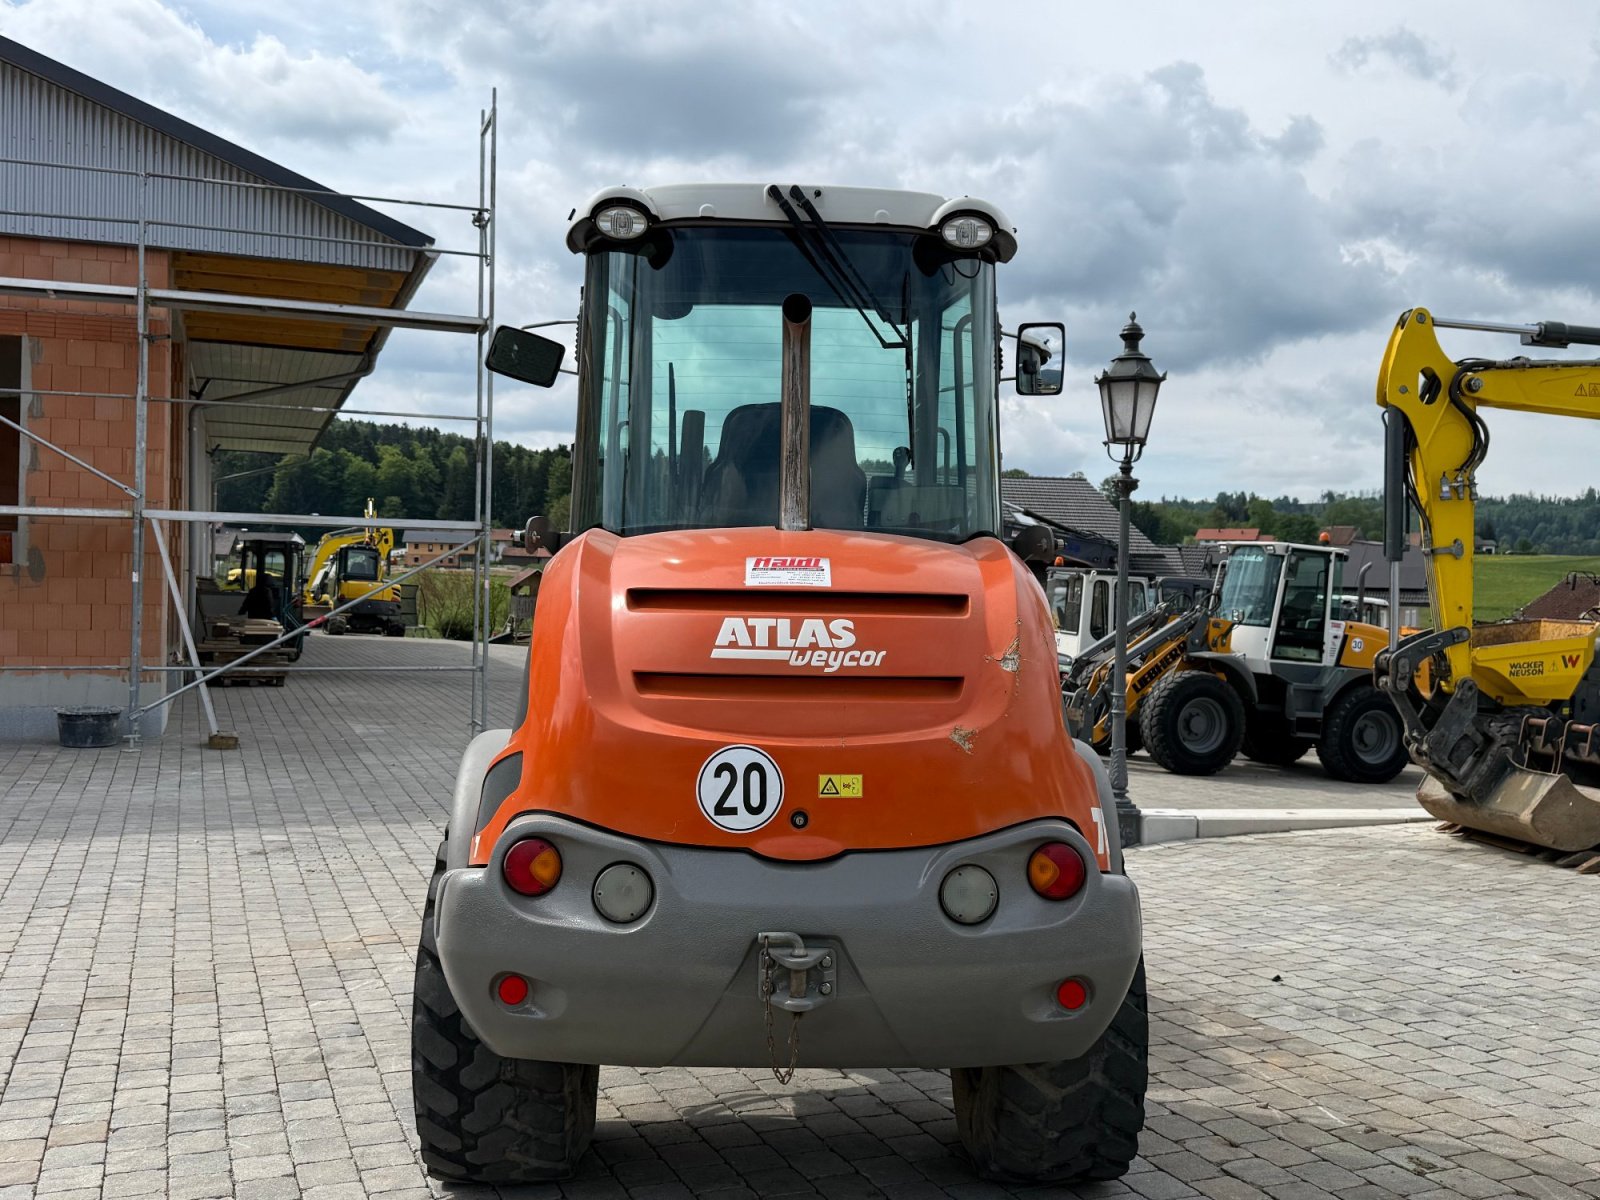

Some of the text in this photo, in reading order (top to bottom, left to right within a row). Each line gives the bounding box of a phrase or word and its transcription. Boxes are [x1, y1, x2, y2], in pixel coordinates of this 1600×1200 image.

[715, 617, 856, 649] ATLAS
[1352, 640, 1363, 649] 30
[789, 649, 887, 672] weycor
[1131, 640, 1187, 693] LIEBHERR
[1509, 661, 1544, 670] WACKER
[1509, 668, 1544, 677] NEUSON
[713, 761, 767, 816] 20
